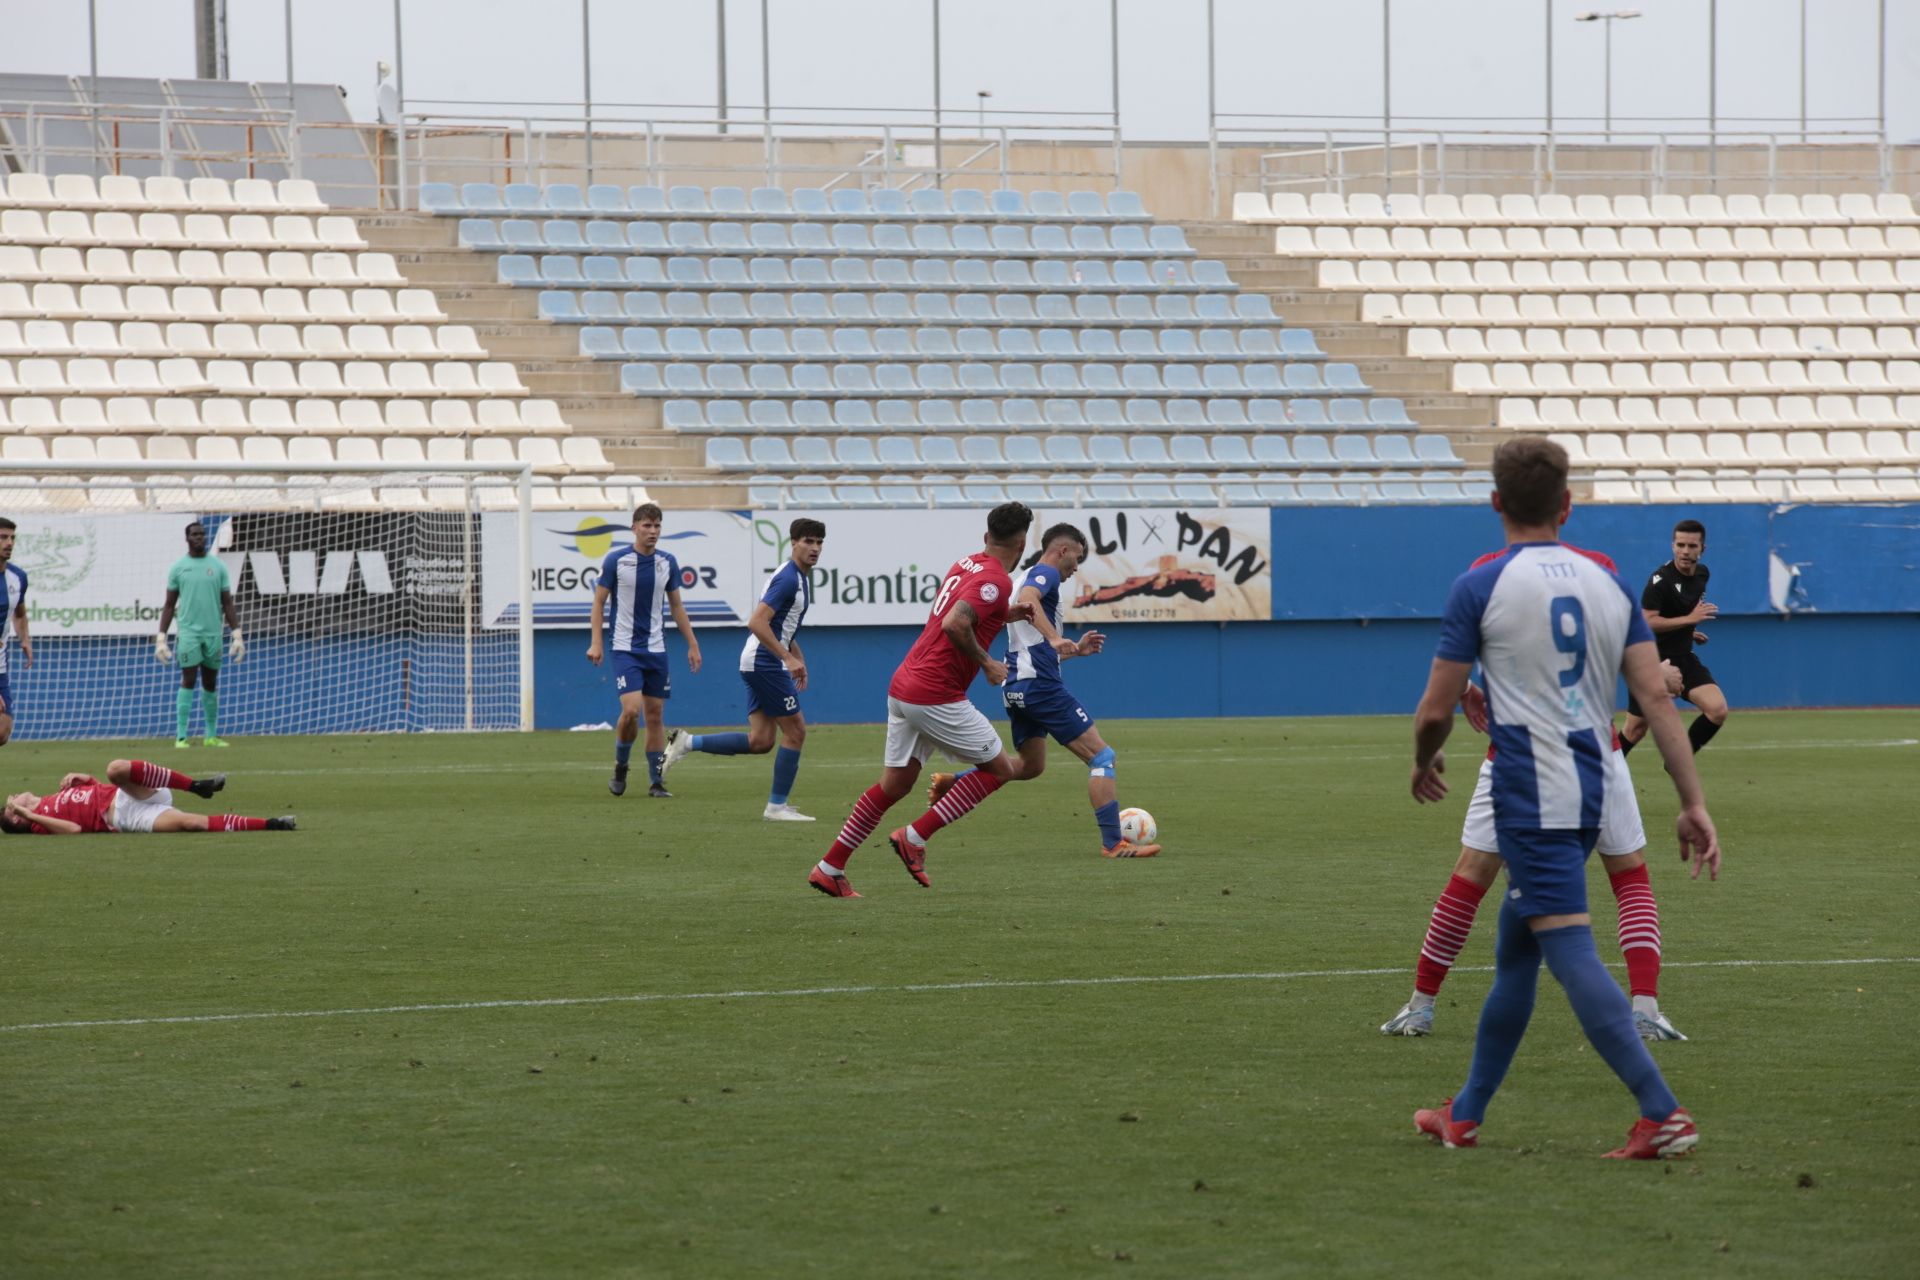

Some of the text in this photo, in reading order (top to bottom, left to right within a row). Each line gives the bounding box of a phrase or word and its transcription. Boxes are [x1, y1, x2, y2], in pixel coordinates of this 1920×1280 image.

[1175, 510, 1266, 585] PAN
[933, 575, 961, 617] 6
[1550, 596, 1588, 688] 9
[784, 696, 797, 711] 22
[1075, 707, 1089, 722] 5
